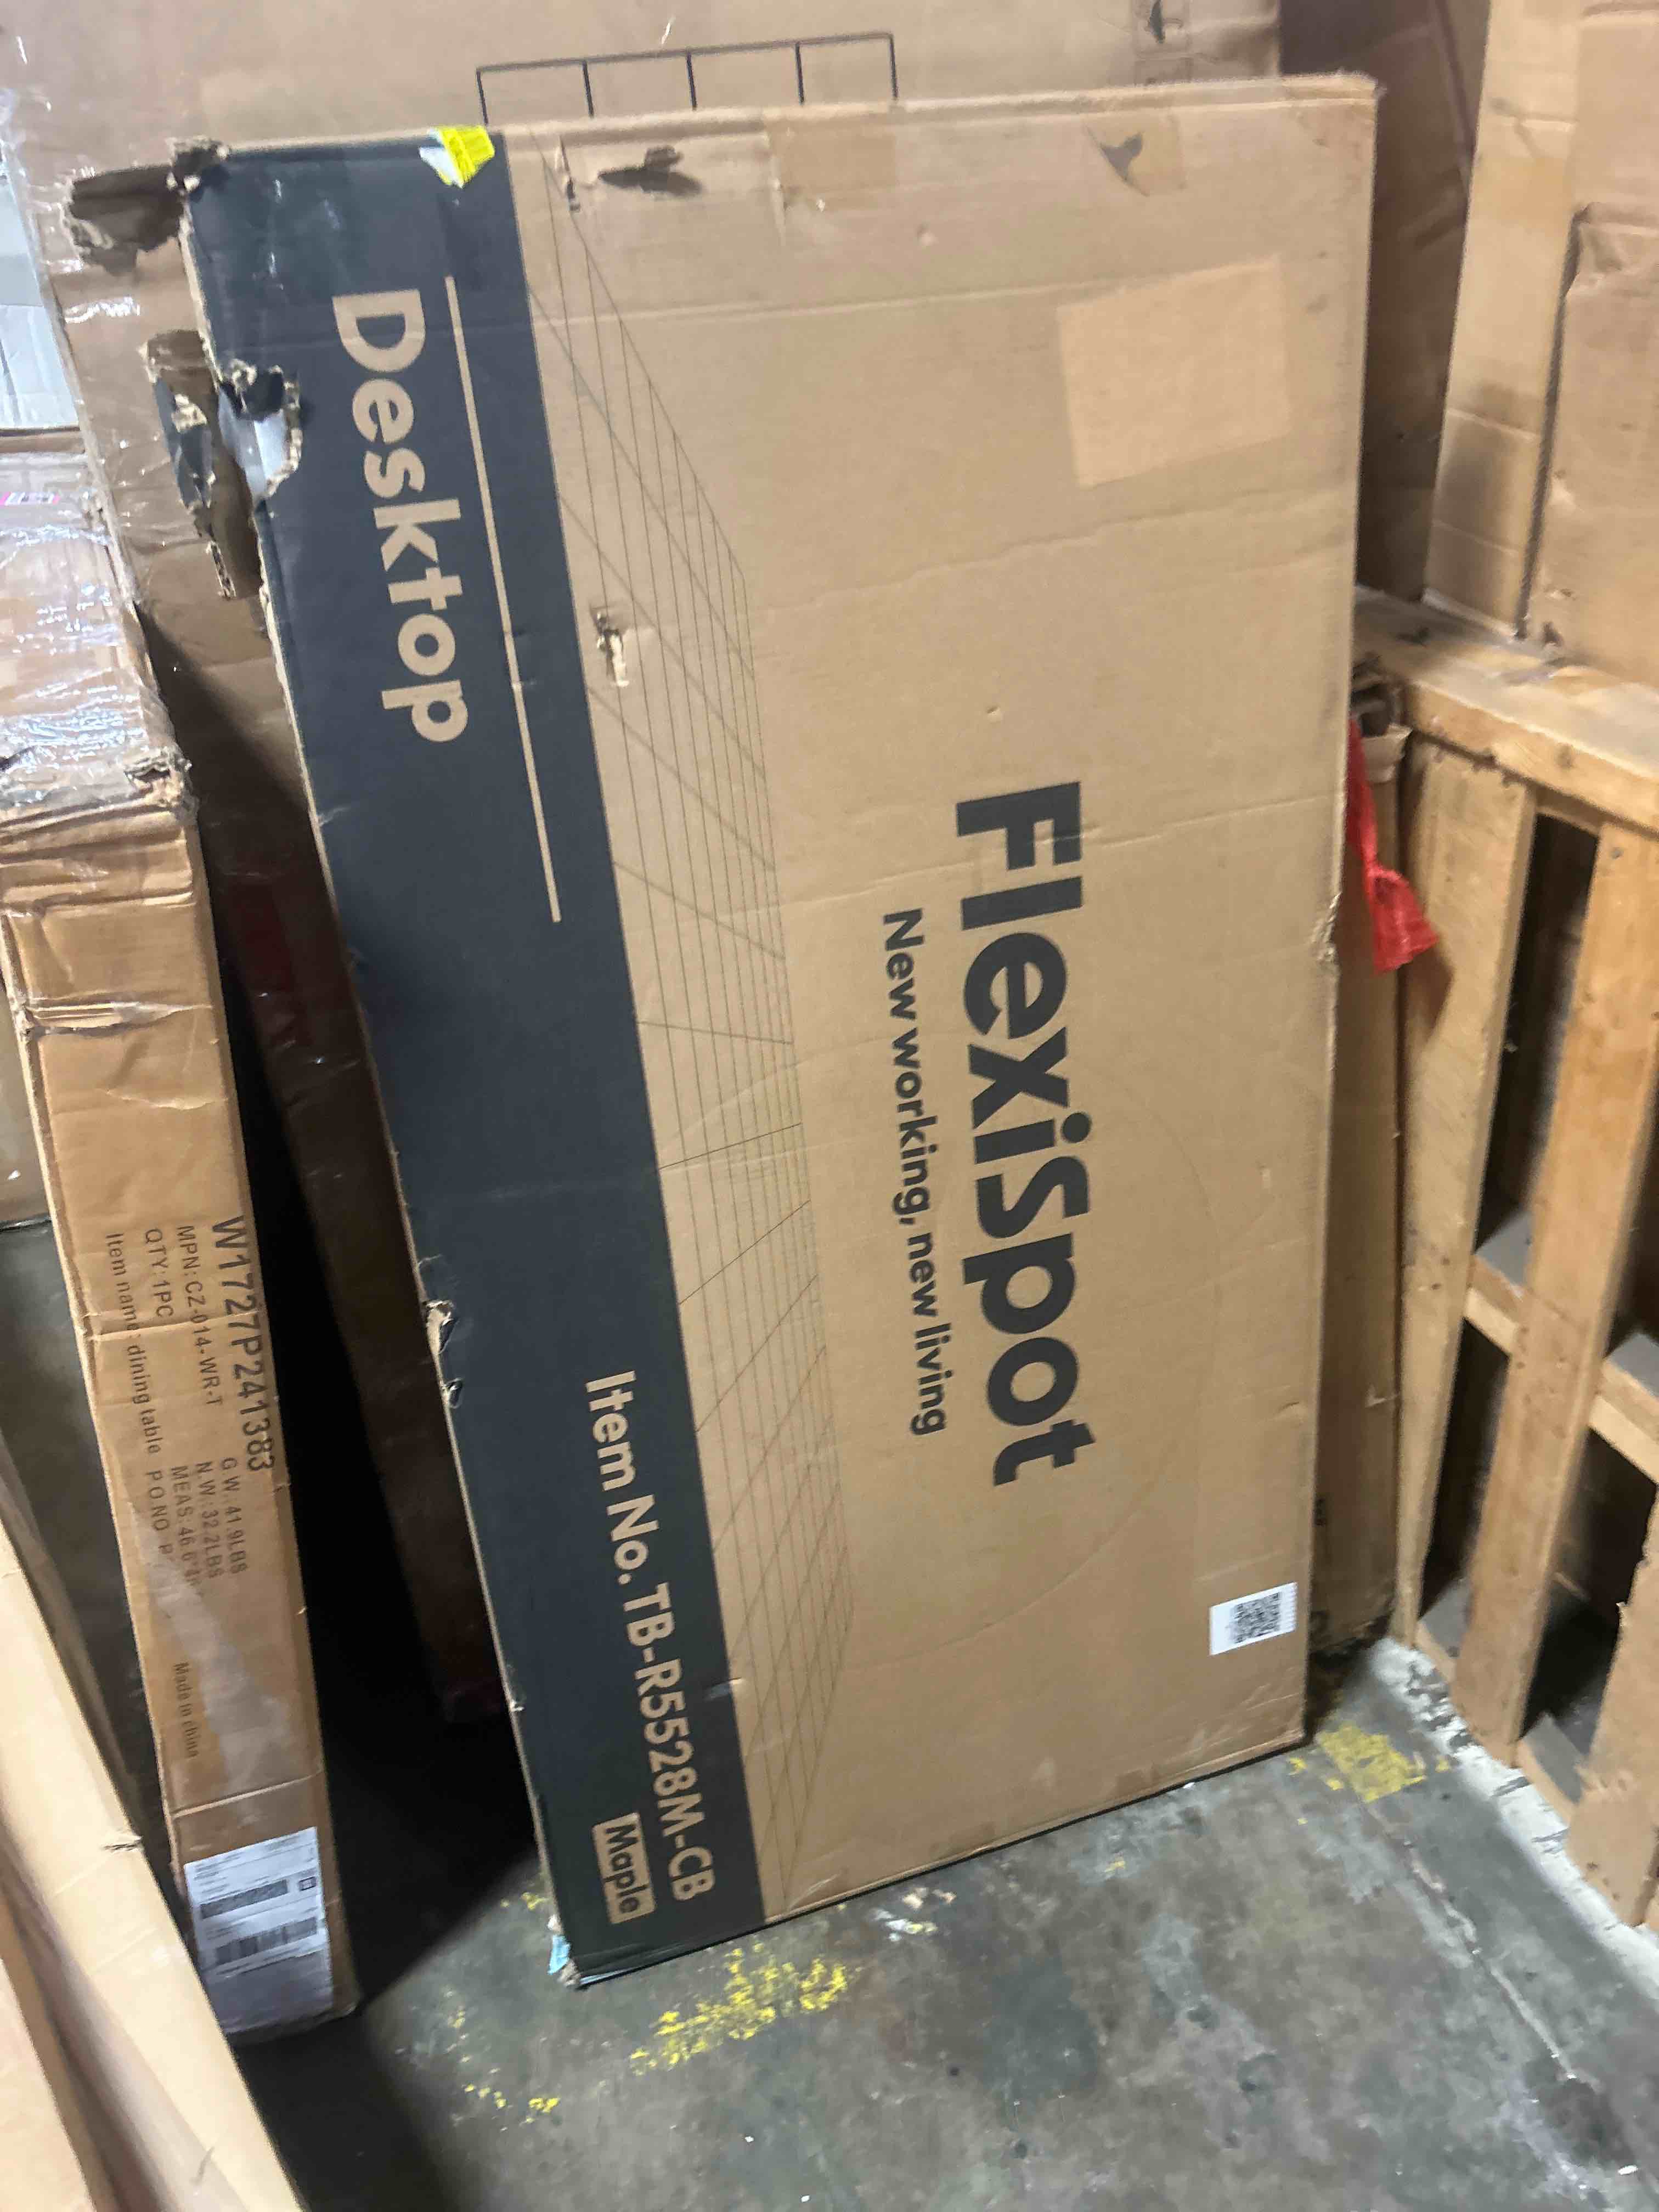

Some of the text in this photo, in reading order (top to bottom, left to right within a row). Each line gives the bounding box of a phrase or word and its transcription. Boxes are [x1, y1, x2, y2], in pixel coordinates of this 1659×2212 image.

[331, 289, 469, 743] Desktop
[883, 908, 953, 1436] New working, new living
[956, 781, 1096, 1487] FlexiSpot
[106, 1233, 127, 1277] Item
[127, 1344, 151, 1405] dining
[140, 1408, 163, 1454] table
[212, 1215, 275, 1472] W1727P241383
[173, 1662, 193, 1701] Made
[584, 1370, 715, 1901] Item No. TB-R5528M-CB
[603, 1824, 646, 1915] Maple
